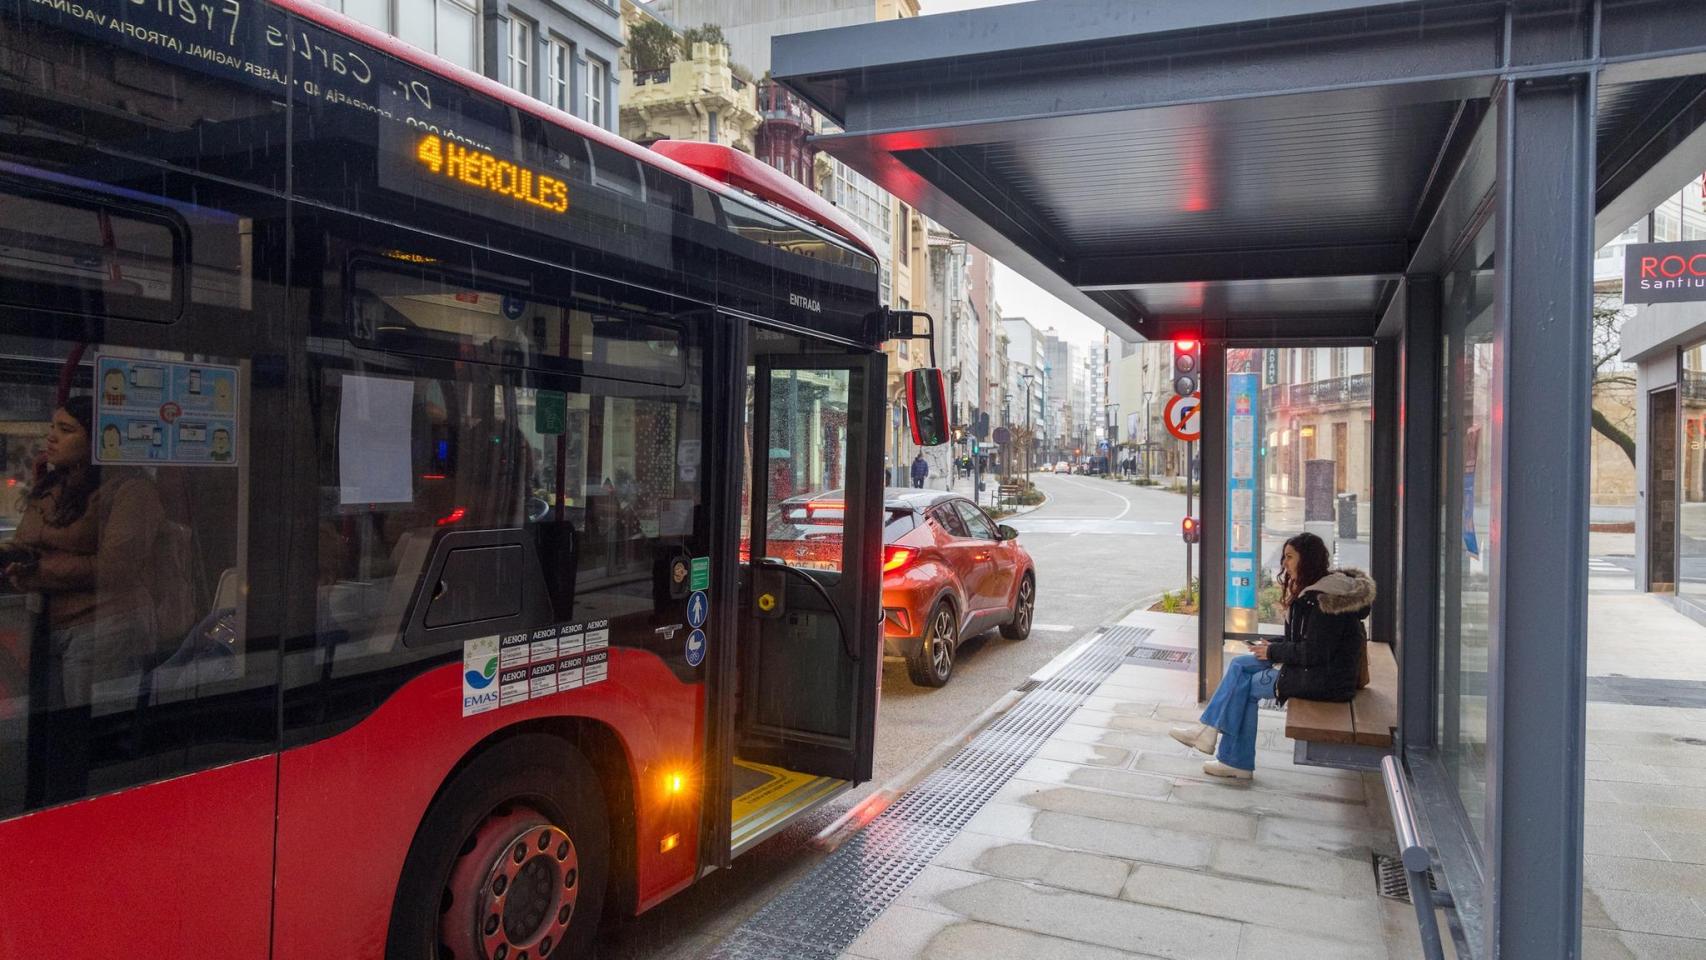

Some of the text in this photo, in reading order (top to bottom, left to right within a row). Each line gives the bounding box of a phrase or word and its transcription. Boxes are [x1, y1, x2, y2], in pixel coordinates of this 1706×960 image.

[417, 134, 443, 172] 4
[790, 293, 821, 313] ENTRADA
[561, 624, 583, 634] AENOR
[587, 619, 608, 630] AENOR
[502, 633, 528, 646] AENOR
[532, 628, 556, 640] AENOR
[560, 658, 582, 670] AENOR
[586, 652, 607, 664] AENOR
[501, 670, 527, 682] AENOR
[532, 664, 555, 676] AENOR
[463, 691, 498, 708] EMAS
